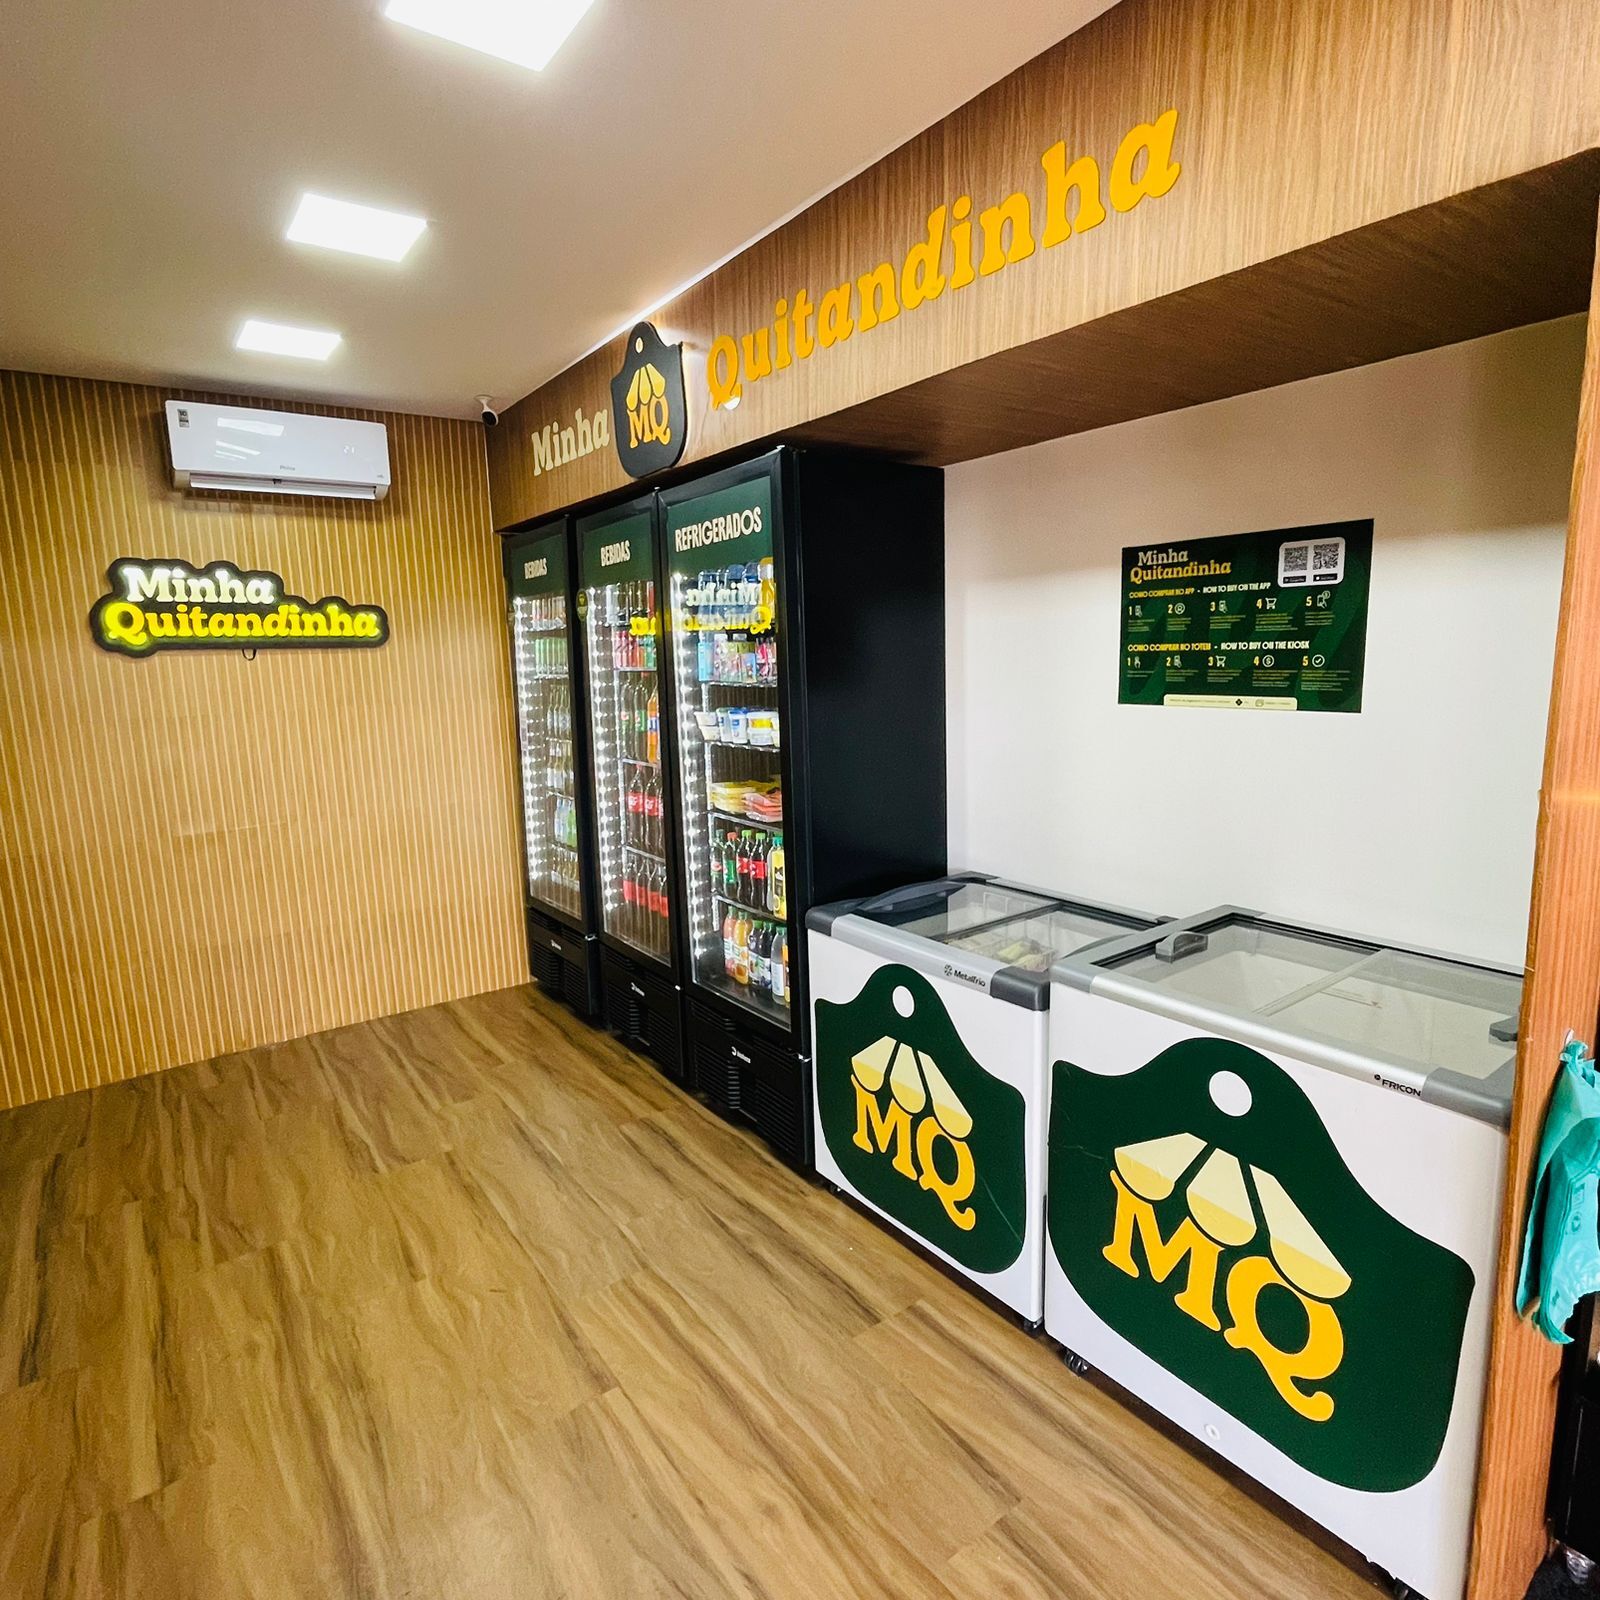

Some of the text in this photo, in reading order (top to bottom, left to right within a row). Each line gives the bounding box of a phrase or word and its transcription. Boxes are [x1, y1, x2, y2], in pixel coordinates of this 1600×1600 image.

[706, 108, 1182, 411] Quitandinha
[626, 394, 671, 449] MQ
[531, 408, 610, 476] Minha
[675, 506, 763, 552] REFRIGERADOS
[601, 540, 631, 567] BEBIDAS
[1137, 548, 1189, 566] Minha
[524, 558, 548, 580] BEBIDAS
[1130, 559, 1232, 585] Quitandinha
[121, 566, 276, 605] Minha
[1129, 591, 1148, 599] COMO
[1218, 585, 1227, 593] TO
[1260, 582, 1272, 590] APP
[1167, 604, 1174, 614] 2
[1209, 601, 1216, 612] 3
[1256, 598, 1263, 609] 4
[1305, 596, 1312, 607] 5
[1128, 606, 1133, 616] 1
[104, 602, 381, 646] Quitandinha
[1127, 644, 1149, 652] COMO
[1220, 642, 1237, 650] HOW
[1238, 641, 1249, 650] TO
[1248, 641, 1261, 650] BUY
[1274, 640, 1287, 649] THE
[1287, 640, 1310, 649] KIOSK
[1127, 657, 1131, 666] 1
[1166, 656, 1171, 666] 2
[1208, 656, 1214, 666] 3
[1253, 656, 1260, 666] 4
[1302, 655, 1309, 666] 5
[953, 969, 986, 988] Metalfrio
[1382, 1078, 1421, 1098] FRICON
[850, 1074, 976, 1231] MQ
[1102, 1170, 1344, 1422] MQ
